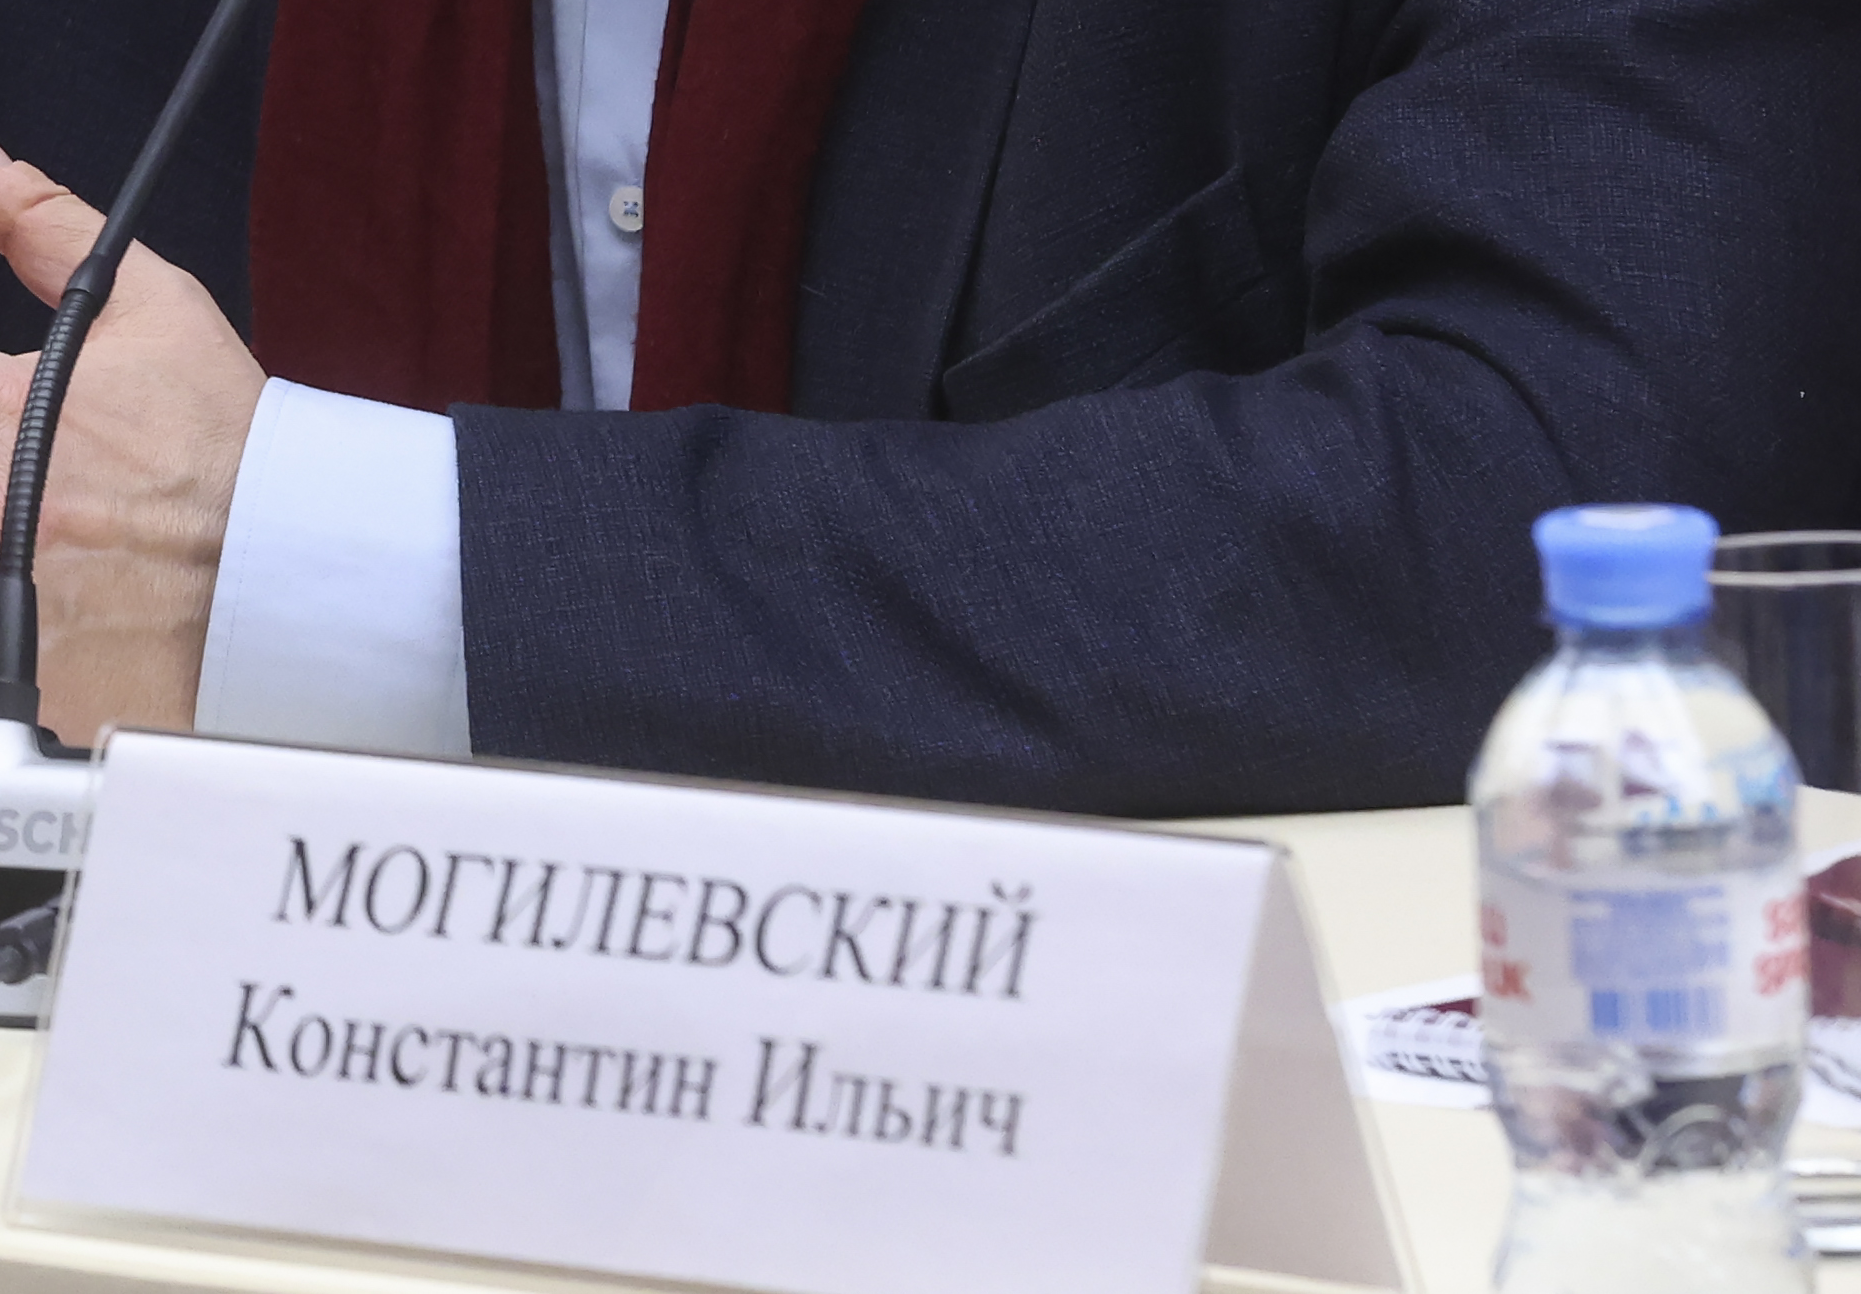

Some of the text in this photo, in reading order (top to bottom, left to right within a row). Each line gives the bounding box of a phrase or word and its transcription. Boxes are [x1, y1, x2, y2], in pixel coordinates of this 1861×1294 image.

[270, 835, 1039, 1001] МОГИЛЕВСКИЙ
[221, 981, 1027, 1160] Константин Ильич
